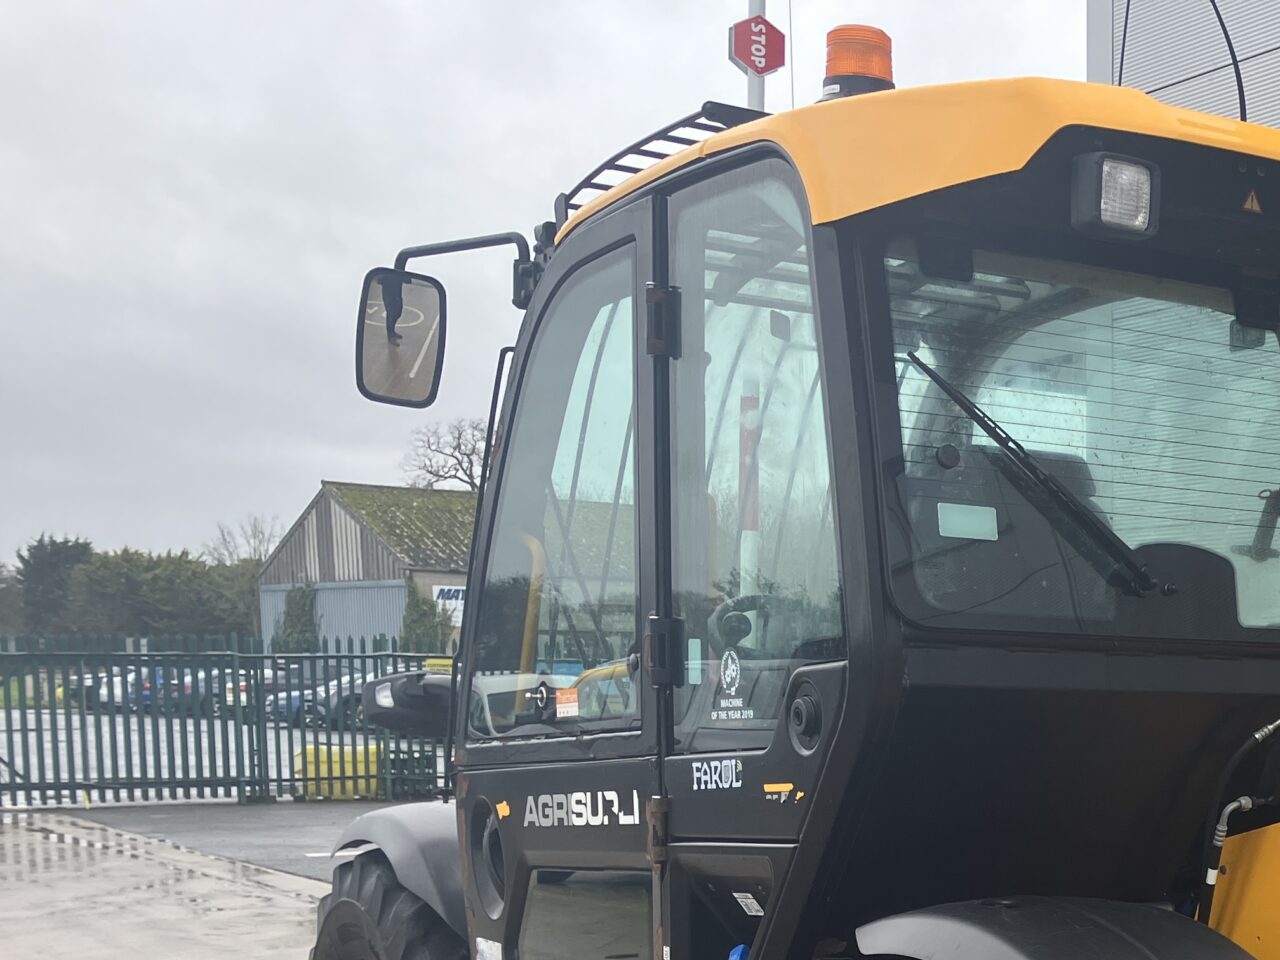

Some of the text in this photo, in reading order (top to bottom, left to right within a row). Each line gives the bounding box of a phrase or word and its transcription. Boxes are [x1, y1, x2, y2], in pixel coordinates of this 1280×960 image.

[750, 22, 766, 68] STOP
[720, 698, 743, 708] MACHINE
[711, 711, 718, 720] OF
[728, 709, 741, 719] YEAR
[691, 759, 743, 790] FAROL
